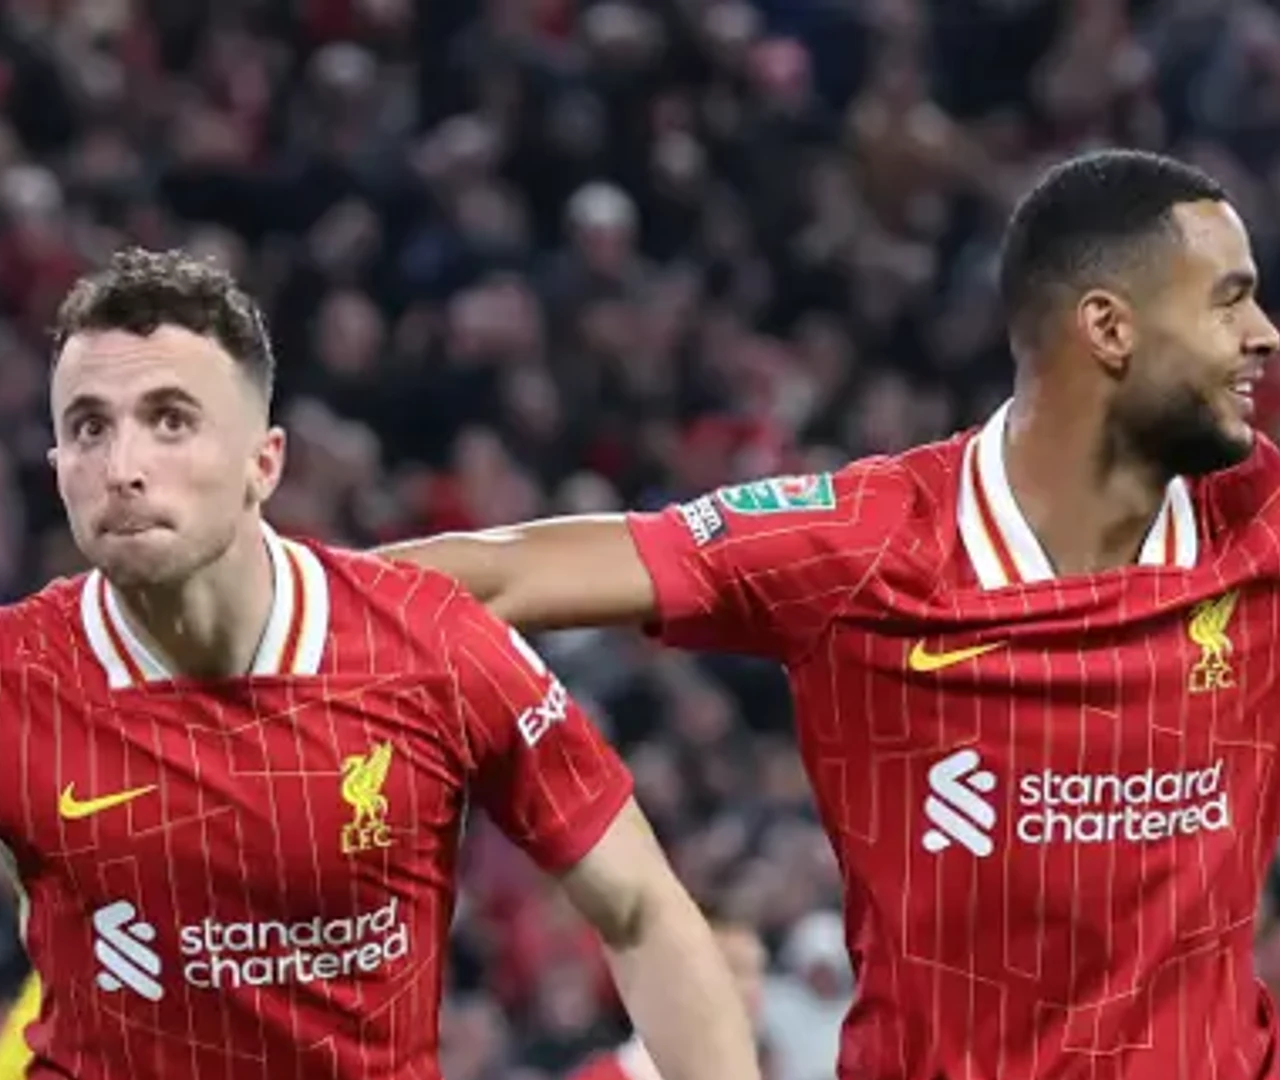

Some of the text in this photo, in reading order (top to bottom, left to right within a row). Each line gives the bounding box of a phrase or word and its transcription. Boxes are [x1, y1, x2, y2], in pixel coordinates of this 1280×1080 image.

[1020, 758, 1223, 806] standard
[1017, 792, 1228, 843] chartered
[180, 896, 398, 954] standard
[184, 923, 408, 988] chartered
